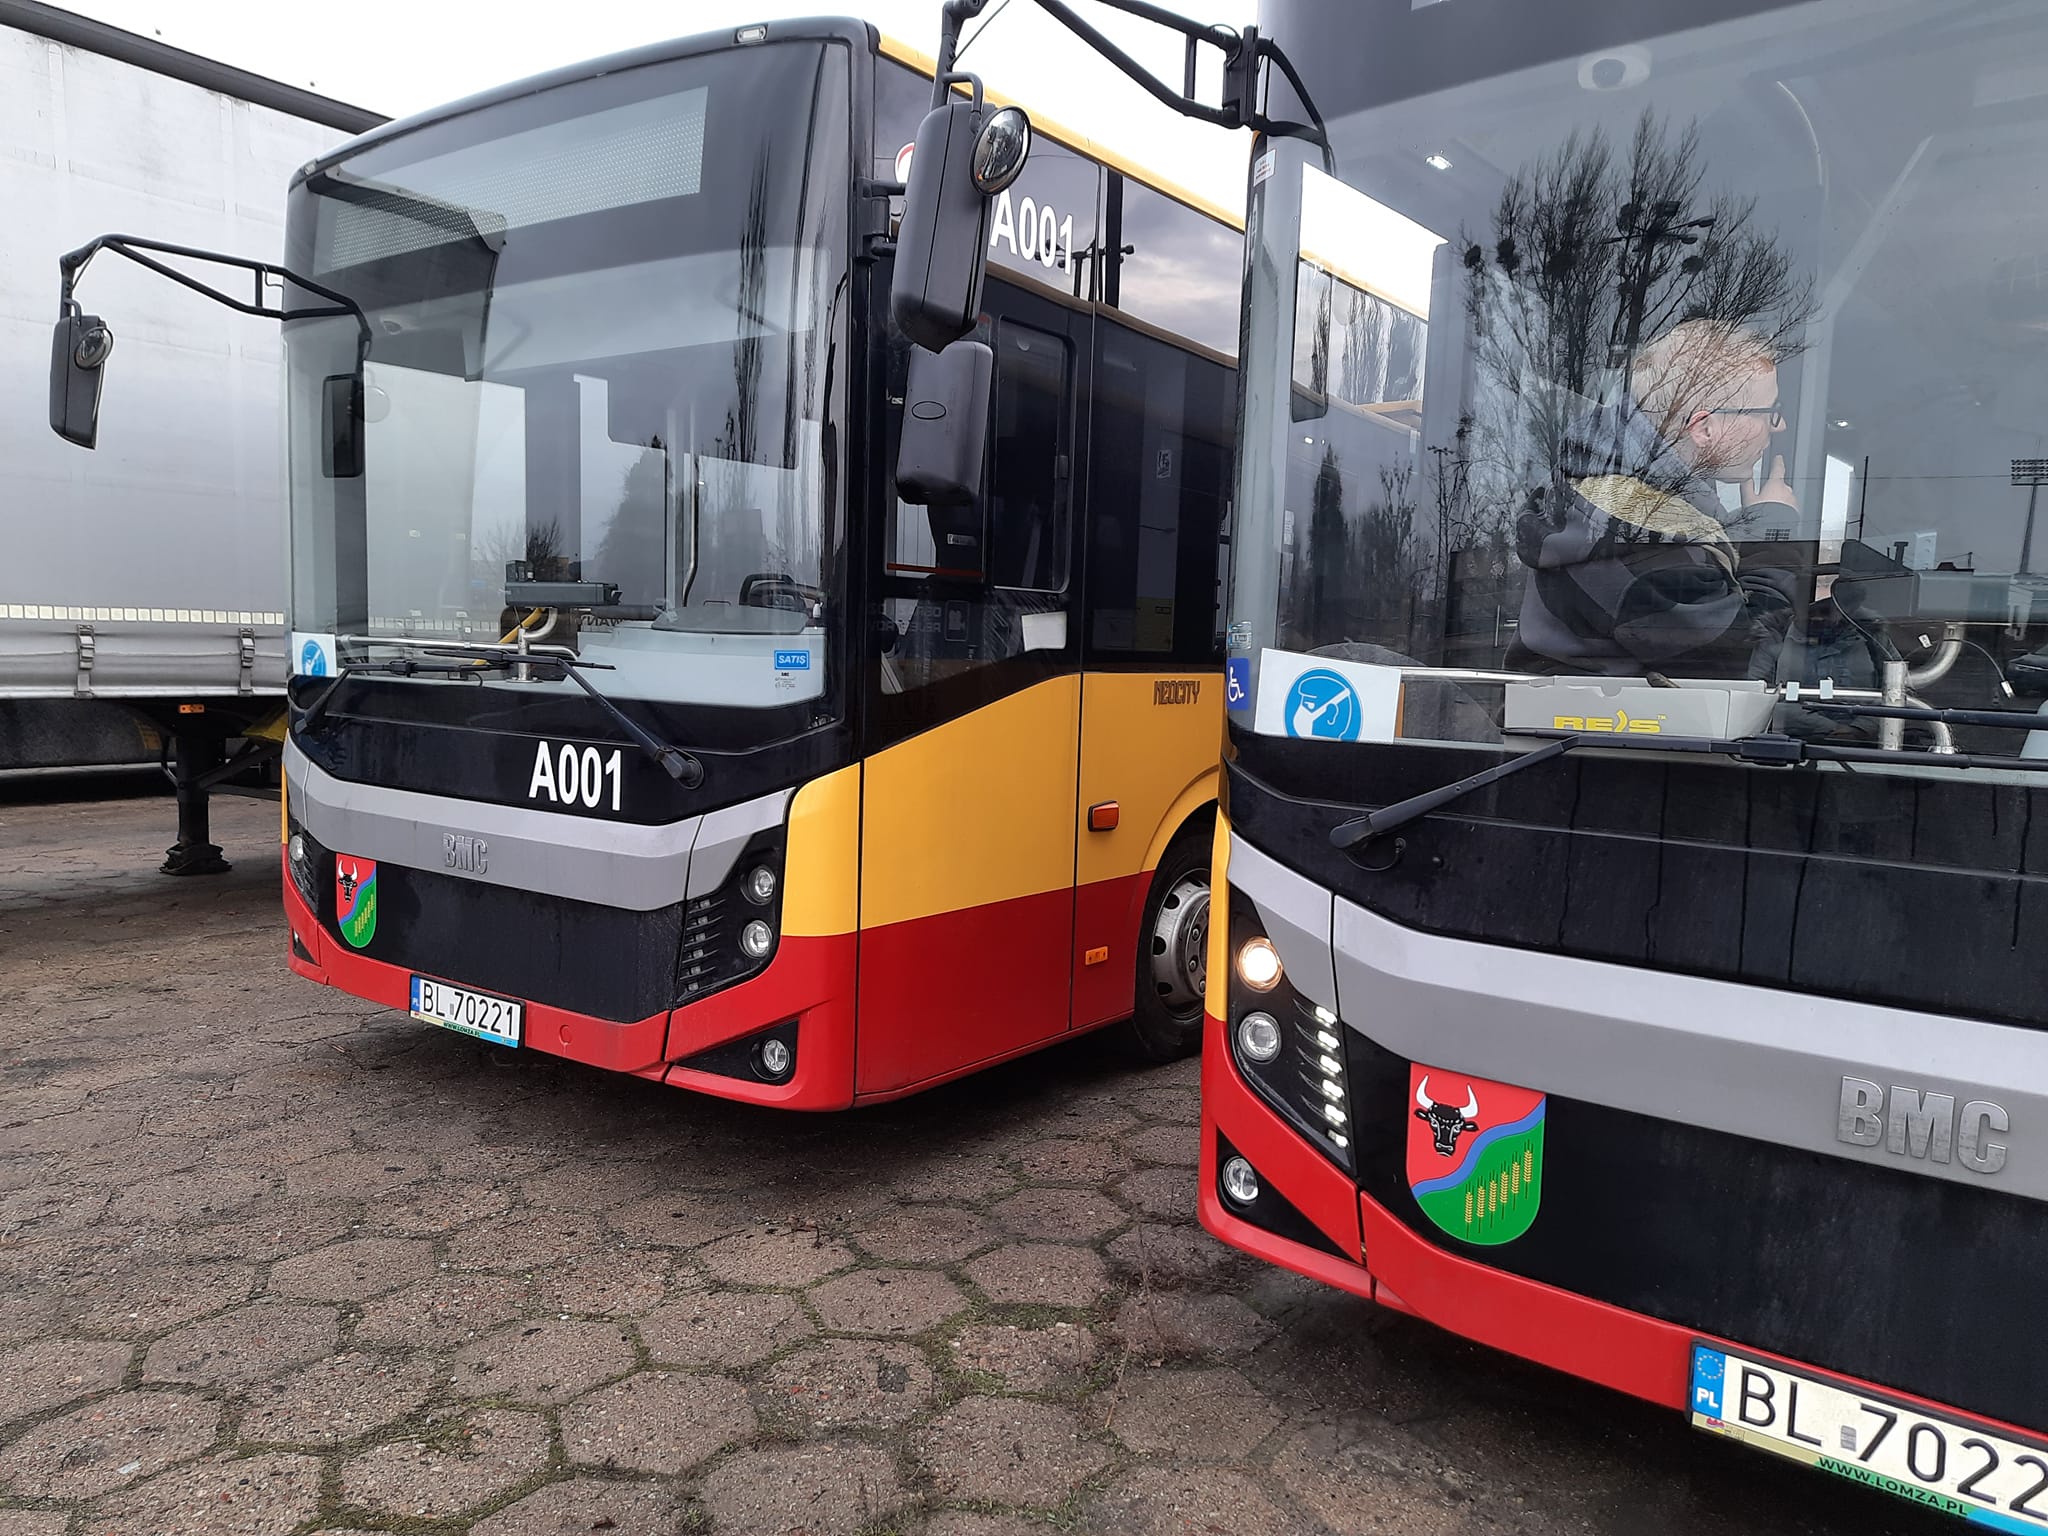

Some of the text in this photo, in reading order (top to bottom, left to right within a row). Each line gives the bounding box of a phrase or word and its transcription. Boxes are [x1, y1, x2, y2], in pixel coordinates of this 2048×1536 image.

[990, 188, 1073, 276] A001
[1153, 680, 1201, 705] NEOCITY
[528, 740, 622, 812] A001
[442, 832, 489, 875] BMC
[412, 997, 420, 1007] PL
[423, 983, 514, 1036] BL 70221
[1838, 1075, 2009, 1174] BMC
[1696, 1387, 1719, 1408] PL
[1739, 1366, 1822, 1447] BL
[1819, 1455, 1968, 1516] WWW.LOMZA.PL
